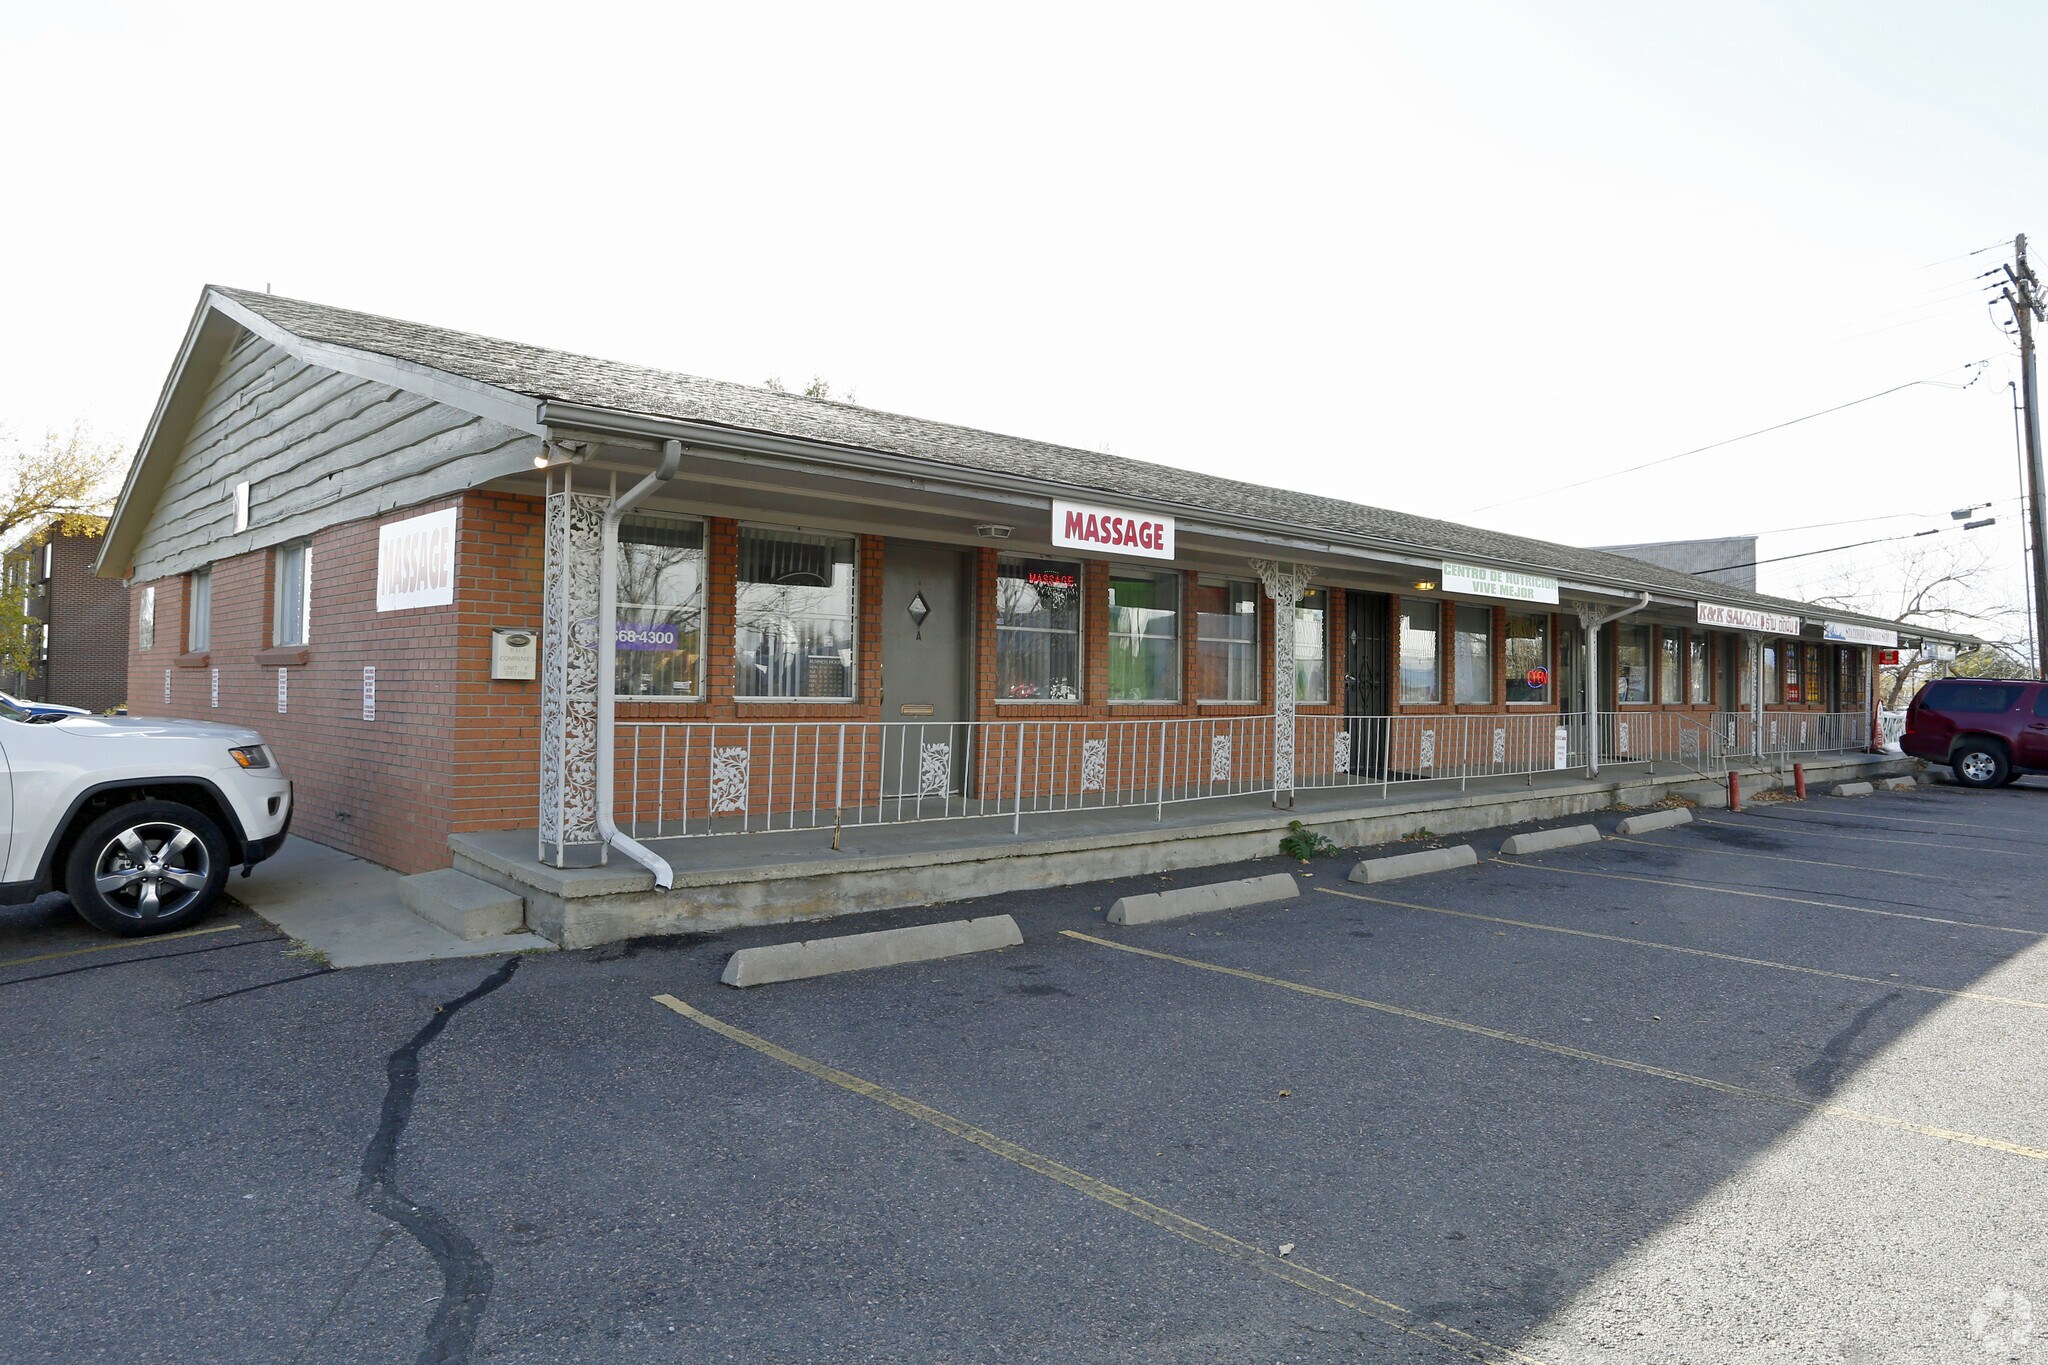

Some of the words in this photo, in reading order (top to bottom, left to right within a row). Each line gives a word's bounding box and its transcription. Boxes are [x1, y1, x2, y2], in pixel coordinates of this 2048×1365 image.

[1065, 510, 1164, 551] MASSAGE
[381, 527, 449, 597] MASSAGE
[1028, 572, 1075, 587] MASSAGE
[1443, 563, 1487, 580] CENTRO
[1489, 570, 1503, 583] DE
[1505, 573, 1558, 590] NUTRICION
[1472, 581, 1496, 594] VIVE
[1499, 585, 1535, 599] MEJOR
[1699, 605, 1725, 623] K&K
[1726, 609, 1759, 627] SALON
[1527, 669, 1548, 684] OPEN
